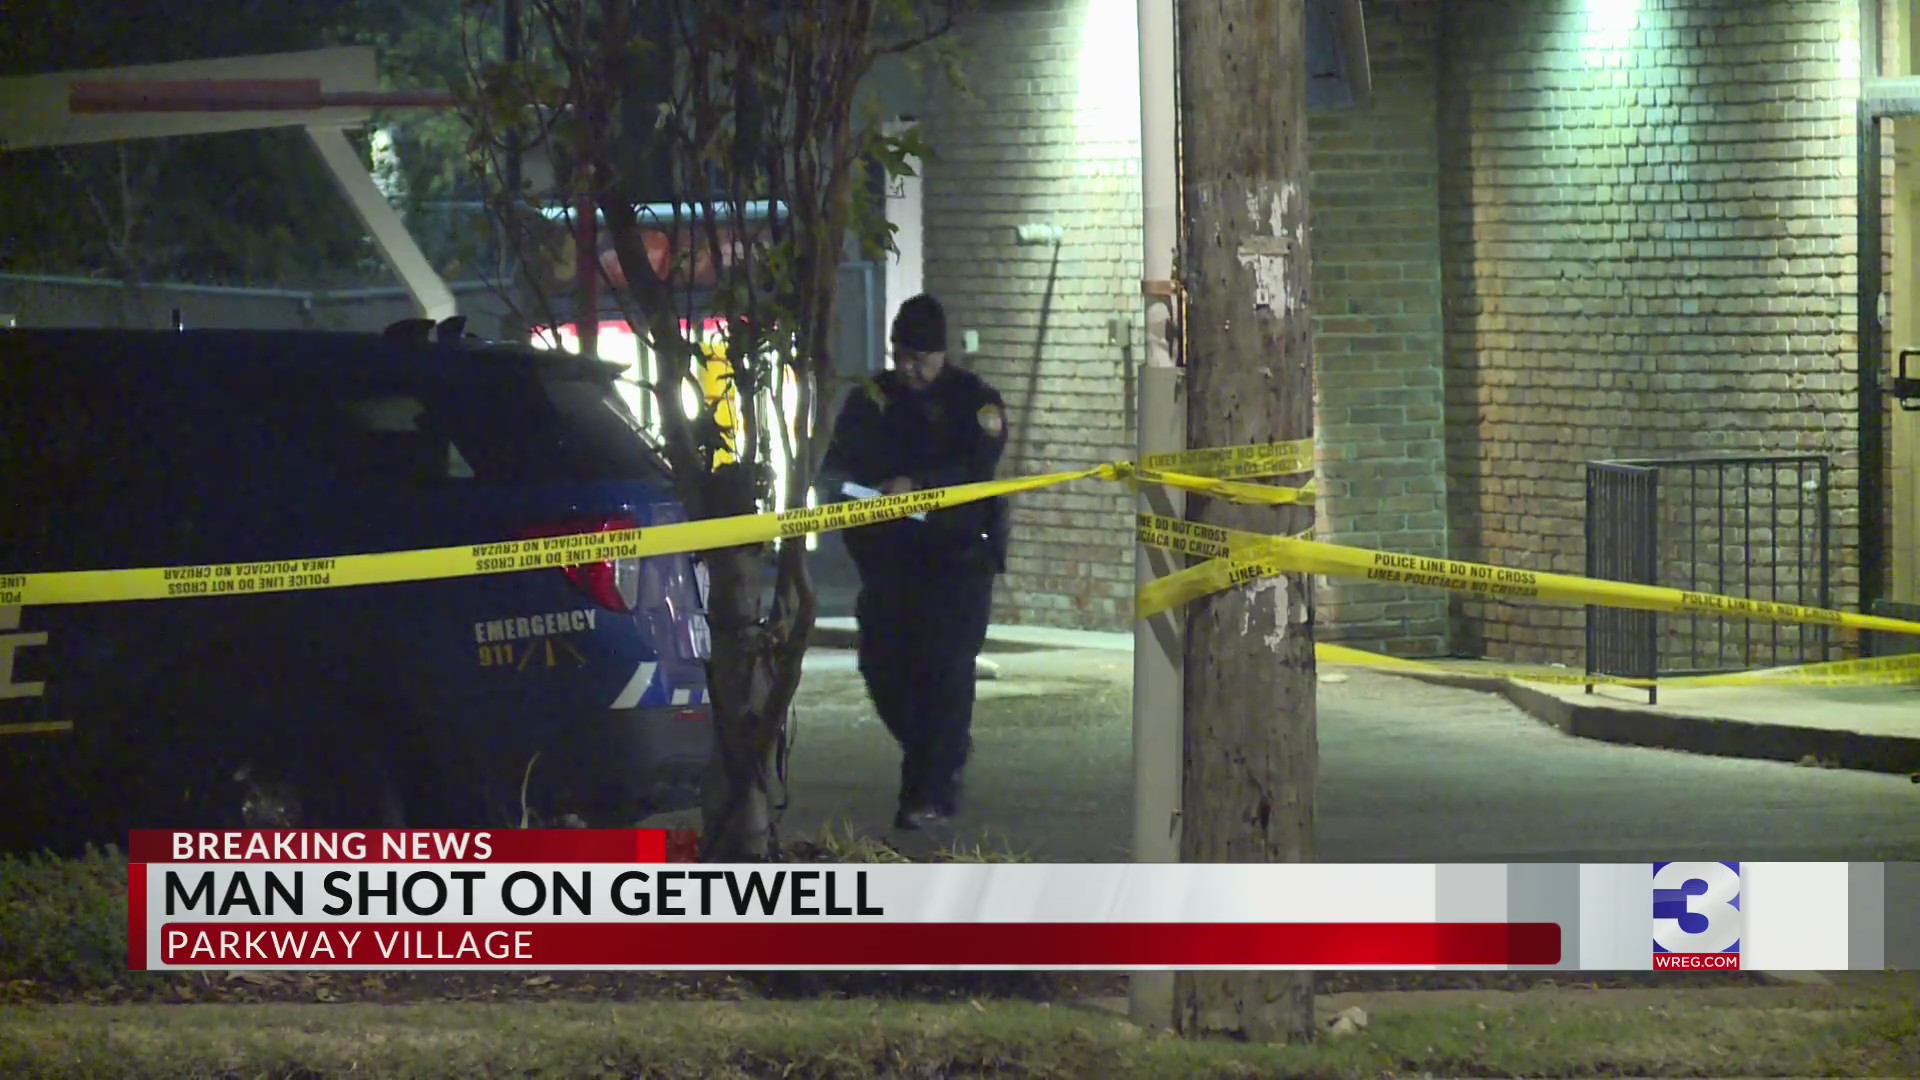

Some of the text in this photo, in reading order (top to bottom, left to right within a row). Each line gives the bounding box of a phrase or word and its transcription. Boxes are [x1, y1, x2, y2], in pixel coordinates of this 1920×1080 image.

[827, 502, 843, 515] NO
[850, 511, 866, 525] DO
[869, 507, 896, 521] LINE
[780, 519, 819, 535] CROSS
[824, 515, 846, 529] NOT
[1155, 518, 1169, 531] DO
[1171, 520, 1191, 536] NOT
[1194, 525, 1228, 543] CROSS
[472, 530, 642, 557] LINEA POLICIACA NO CRUZAR
[1172, 537, 1186, 550] NO
[1189, 541, 1230, 559] CRUZAR
[476, 545, 637, 571] POLICE LINE DO NOT CROSS
[164, 559, 336, 580] LINEA POLICIACA NO CRUZAR
[1229, 564, 1264, 584] LINEA
[1367, 568, 1401, 582] LINEA
[1374, 553, 1536, 585] POLICE LINE DO NOT CROSS
[168, 572, 330, 595] POLICE LINE DO NOT CROSS
[475, 608, 597, 643] EMERGENCY
[479, 644, 514, 667] 911
